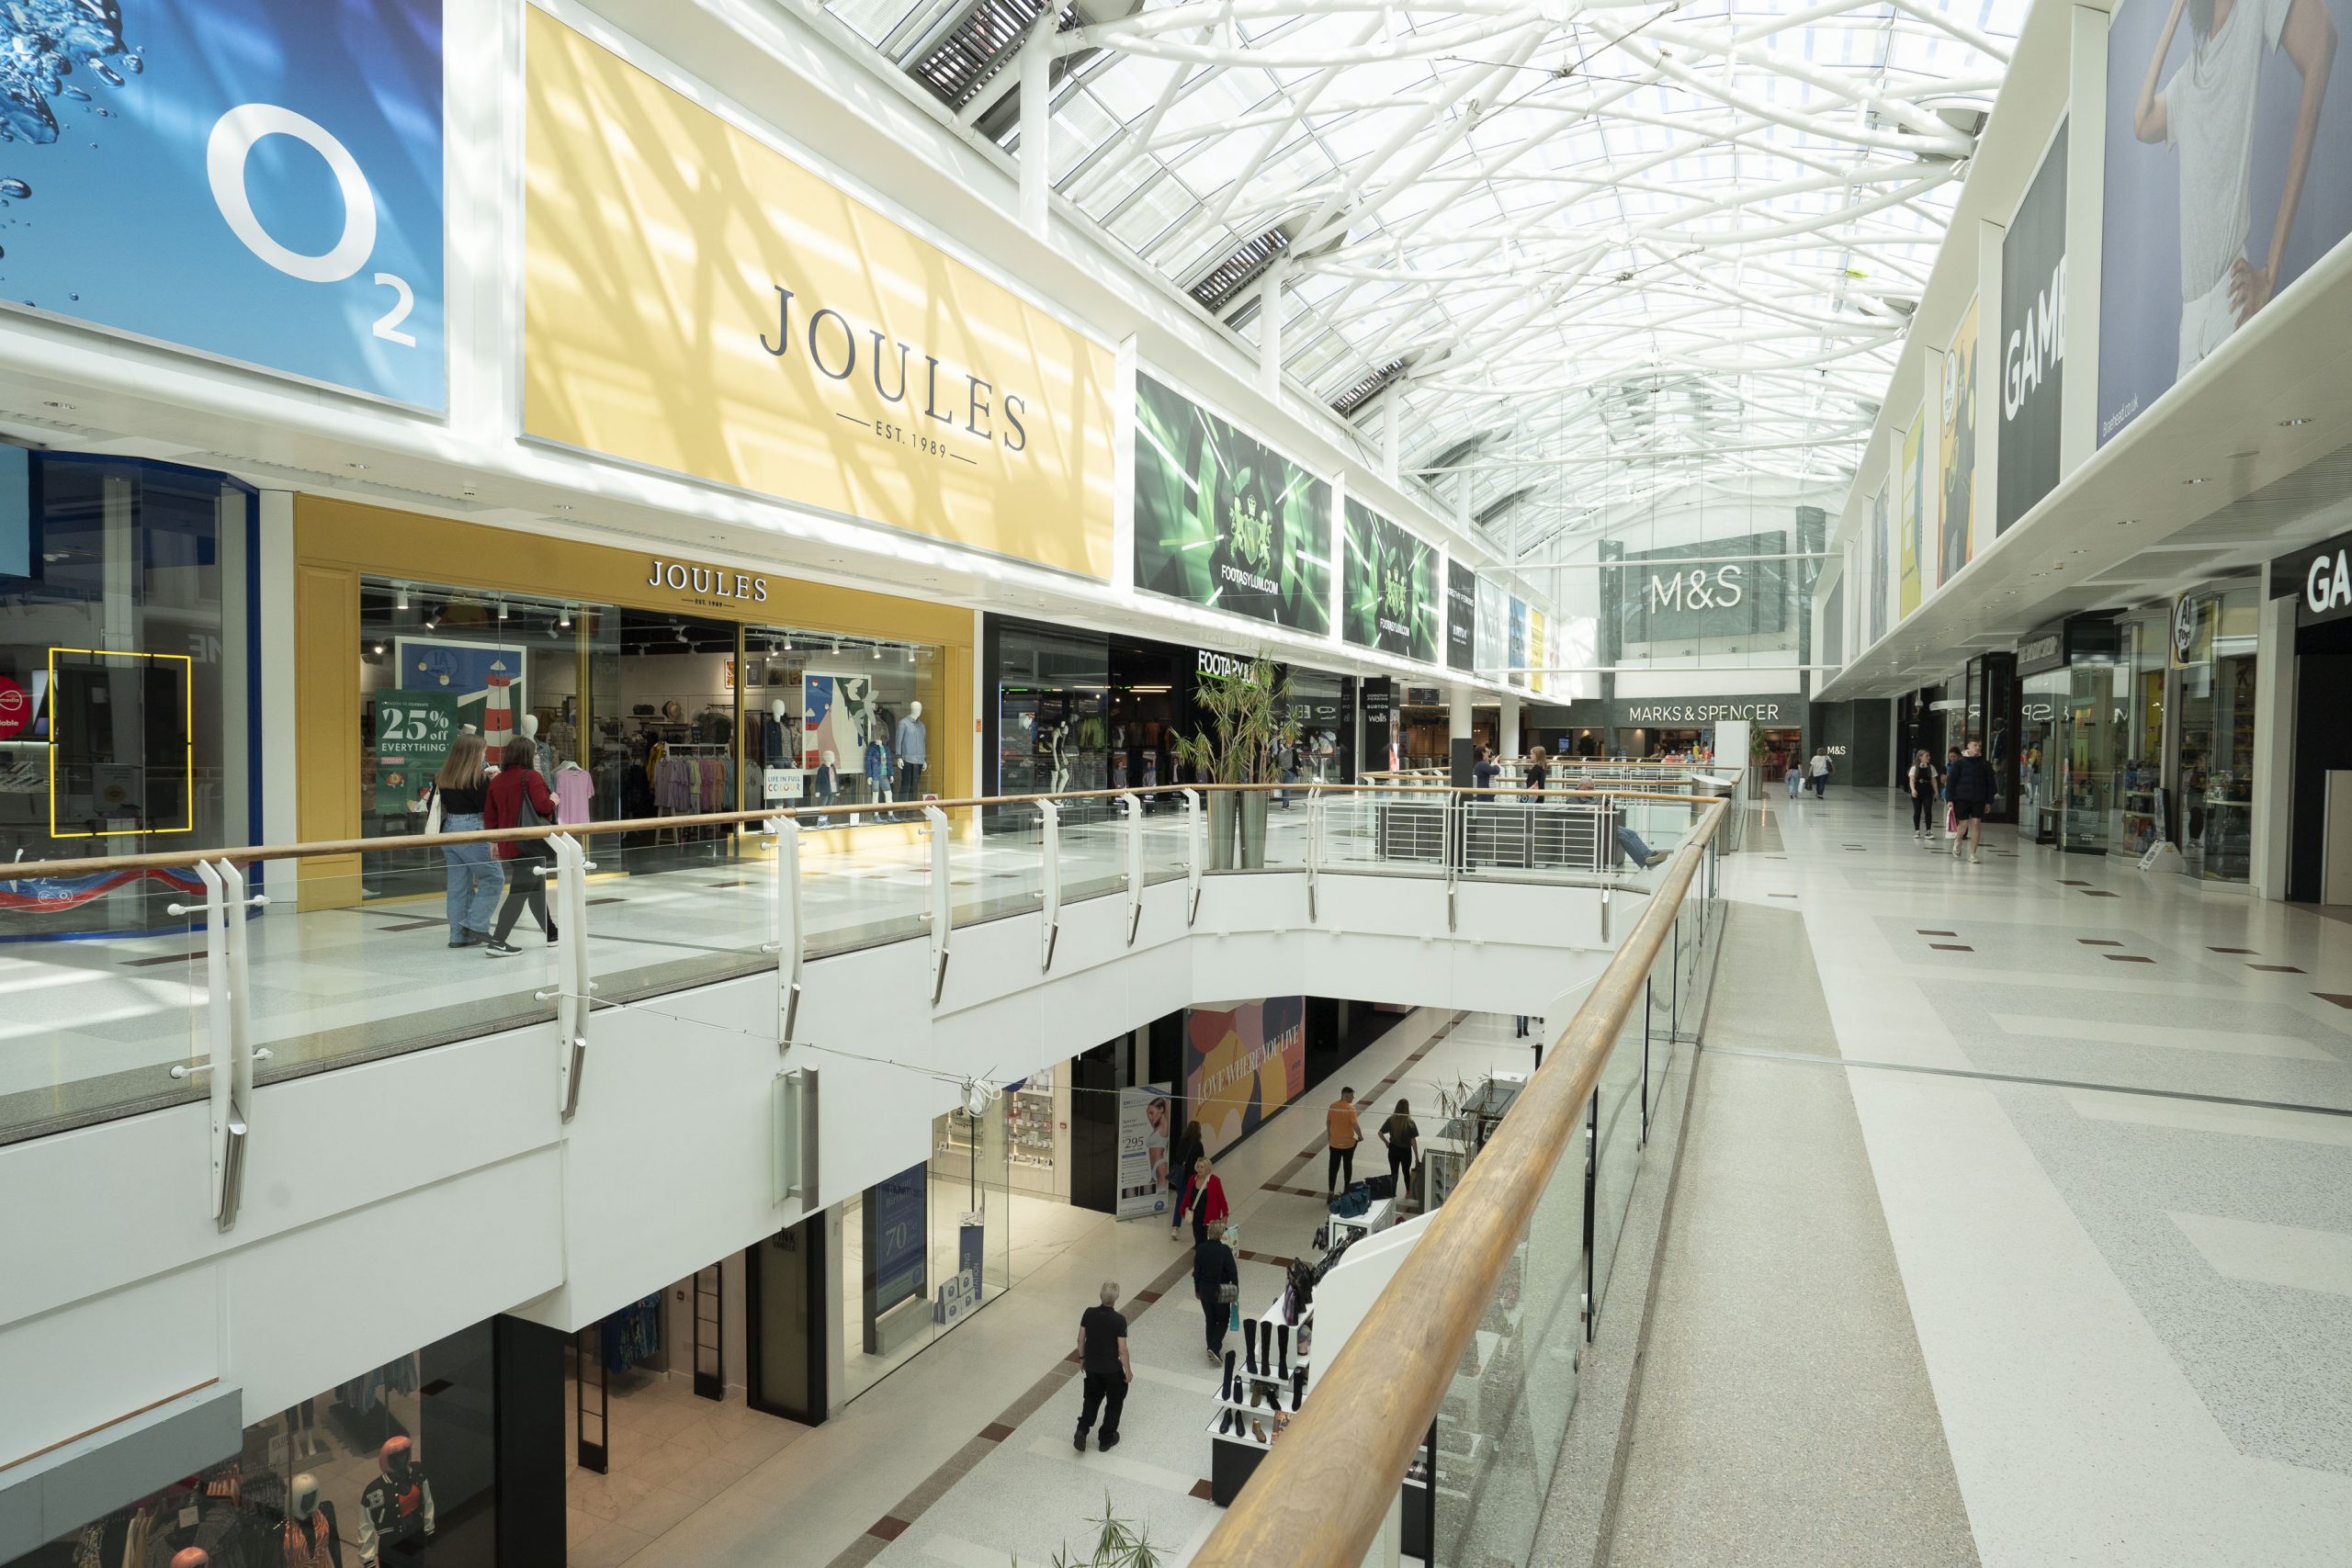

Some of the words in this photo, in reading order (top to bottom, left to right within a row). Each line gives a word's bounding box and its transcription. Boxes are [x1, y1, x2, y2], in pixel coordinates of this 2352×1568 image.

[207, 103, 416, 348] O2
[759, 284, 1027, 452] JOULES
[2102, 392, 2139, 437] Braehead.co.uk
[876, 419, 906, 446] EST.
[911, 434, 946, 458] 1989
[649, 560, 767, 602] JOULES
[1221, 564, 1279, 595] FOOTASYLUM.COM
[1651, 565, 1742, 615] M&S
[1630, 706, 1681, 722] MARKS
[1684, 705, 1695, 721] &
[1698, 704, 1779, 721] SPENCER
[430, 730, 449, 740] off
[1826, 746, 1846, 755] M&S
[1197, 1067, 1226, 1105] LOVE
[1225, 1048, 1262, 1087] WHERE
[1261, 1036, 1280, 1064] YOU
[1280, 1024, 1300, 1053] LIVE
